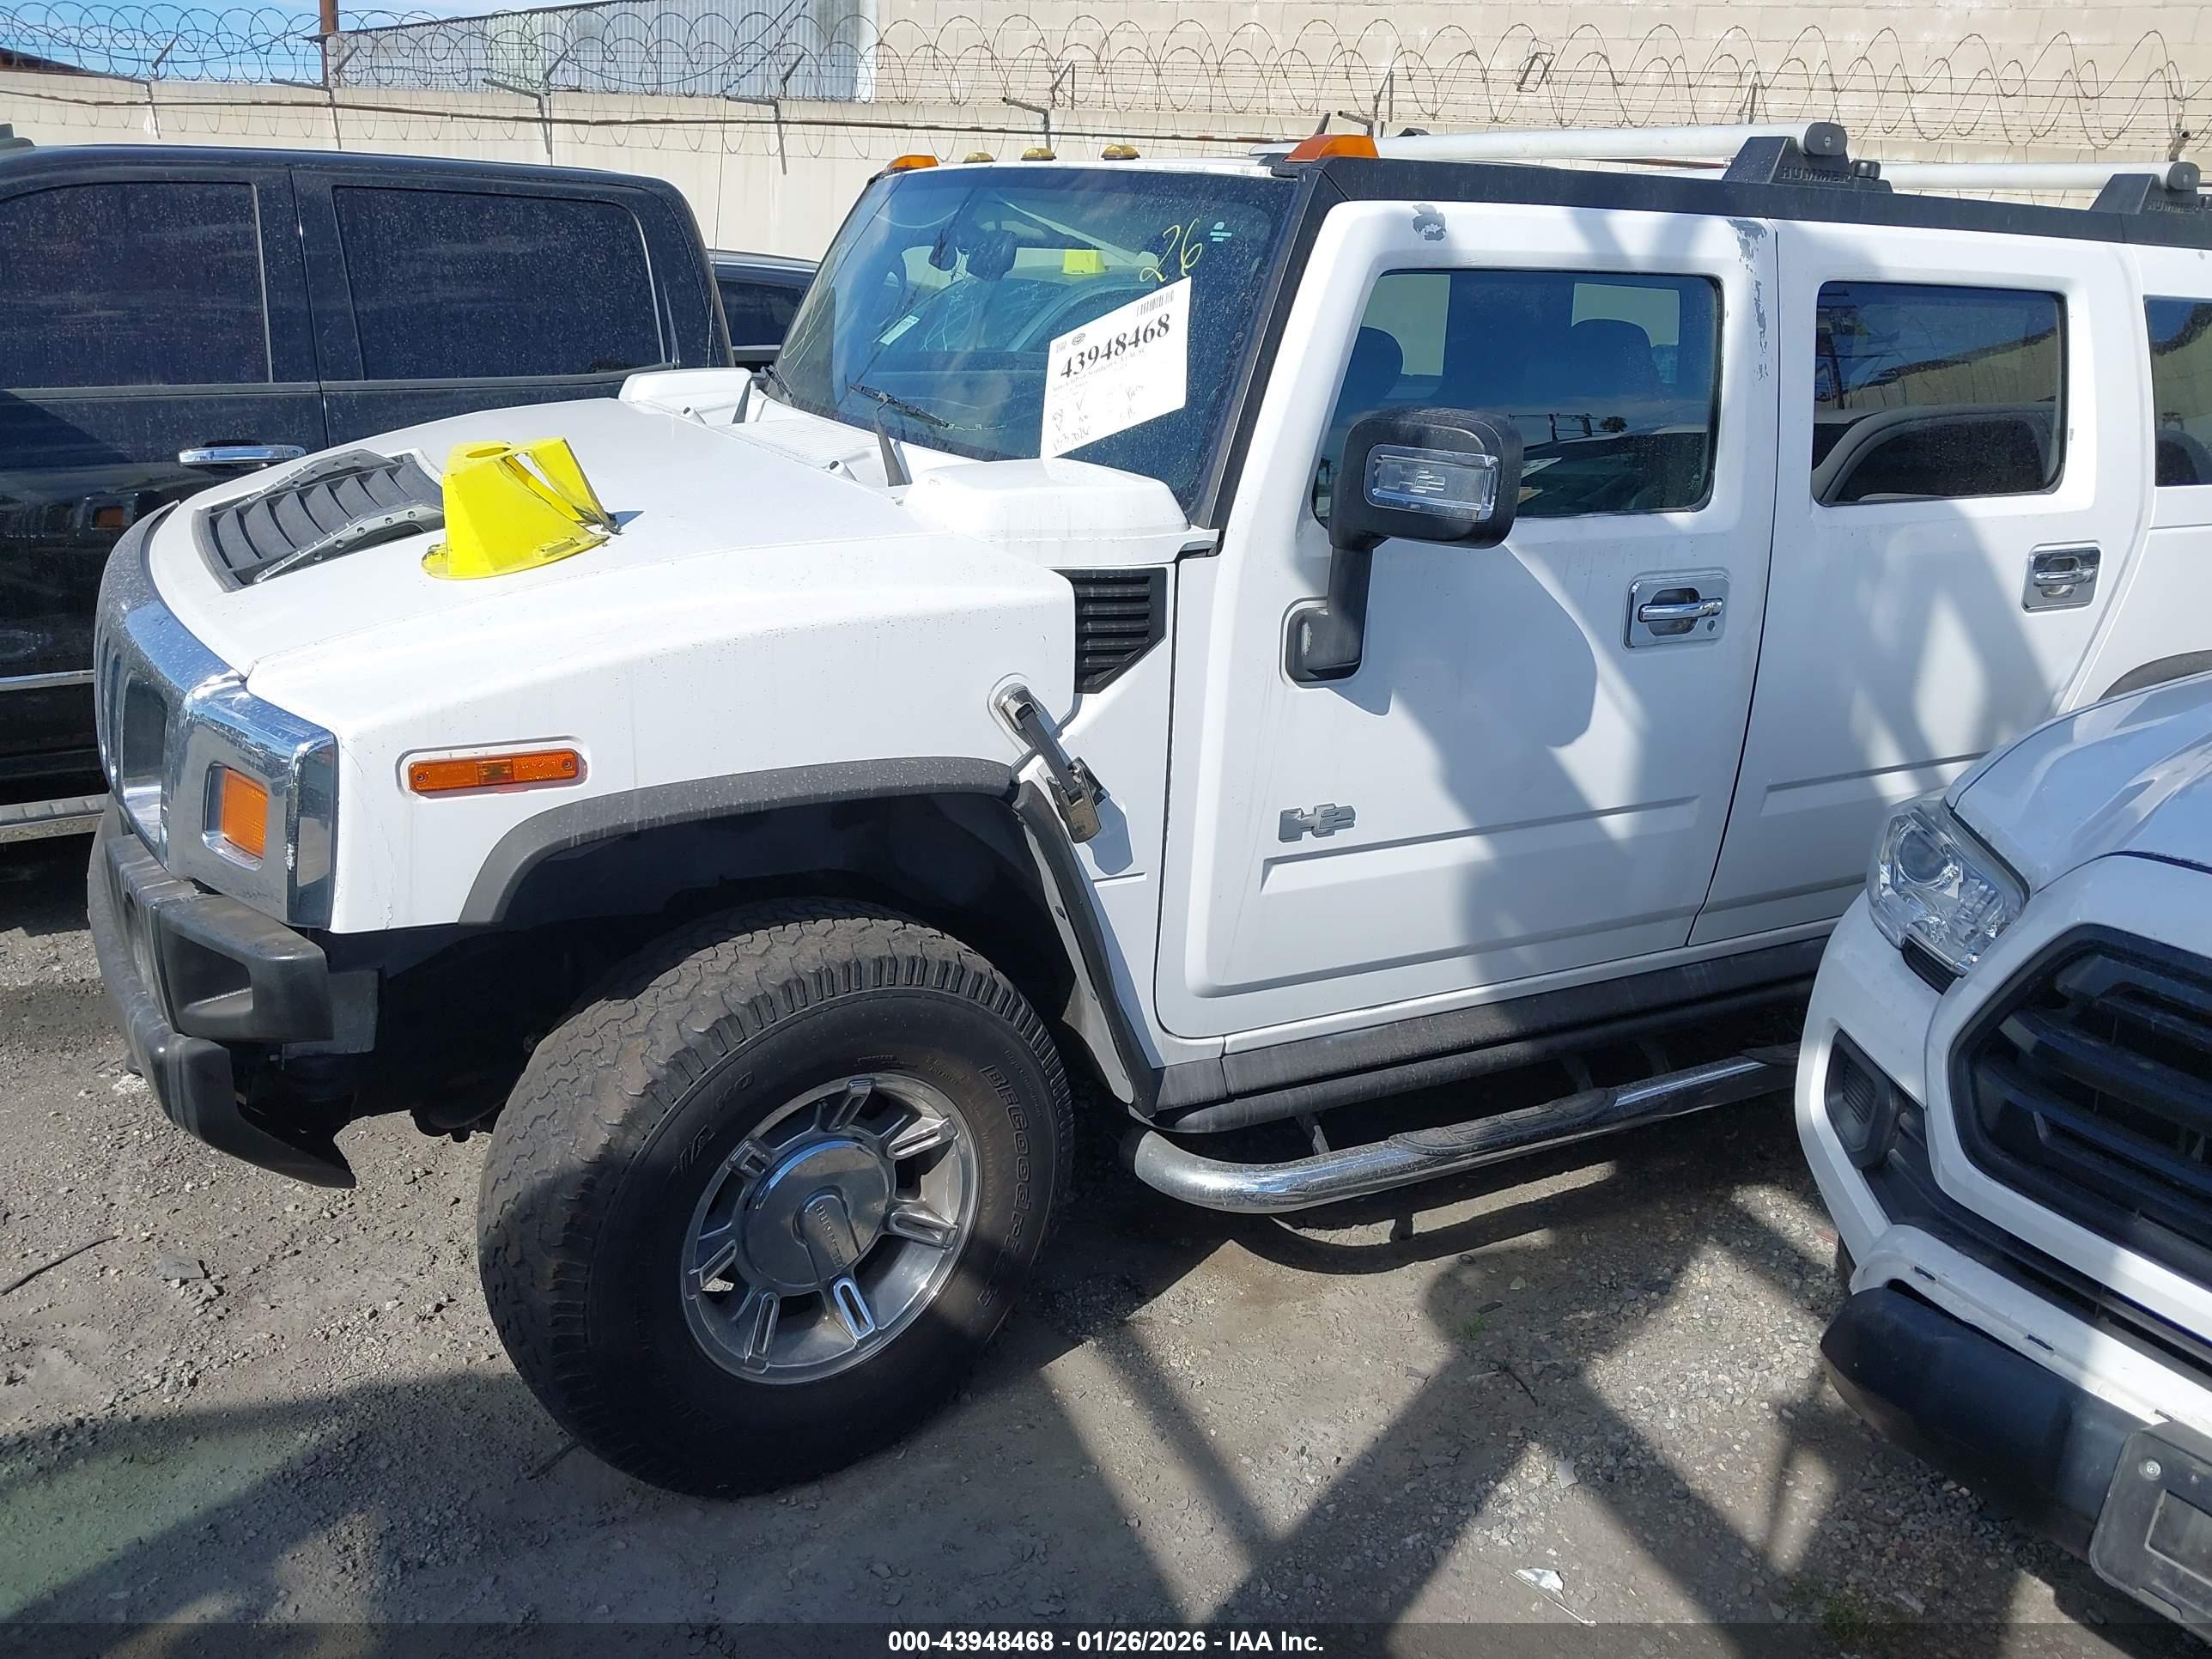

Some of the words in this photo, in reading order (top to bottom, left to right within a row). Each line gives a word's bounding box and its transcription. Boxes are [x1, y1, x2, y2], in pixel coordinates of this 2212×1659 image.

[1139, 217, 1203, 283] 26
[1060, 313, 1170, 379] 43948468
[1278, 802, 1357, 844] H2
